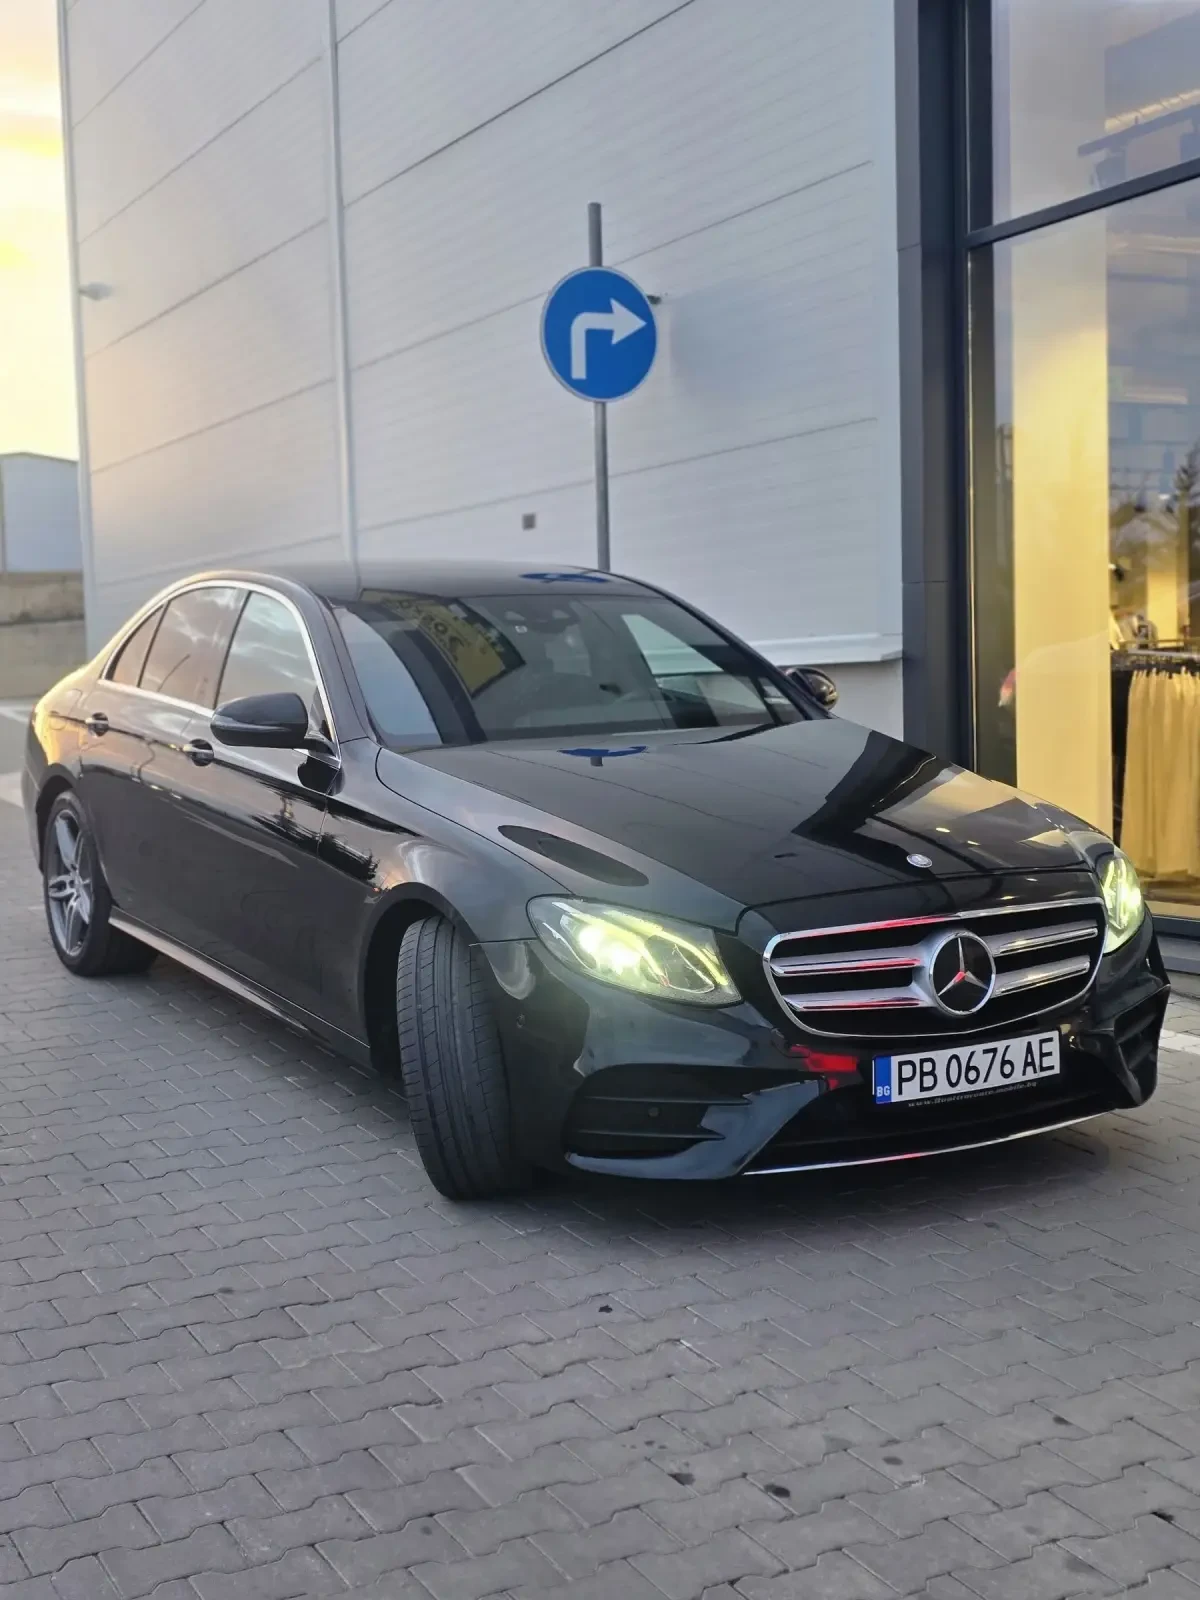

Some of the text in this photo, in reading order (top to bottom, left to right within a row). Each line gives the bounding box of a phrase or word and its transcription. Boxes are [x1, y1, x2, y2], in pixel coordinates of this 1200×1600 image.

[898, 1036, 1055, 1095] PB 0676 AE
[876, 1085, 891, 1097] BG
